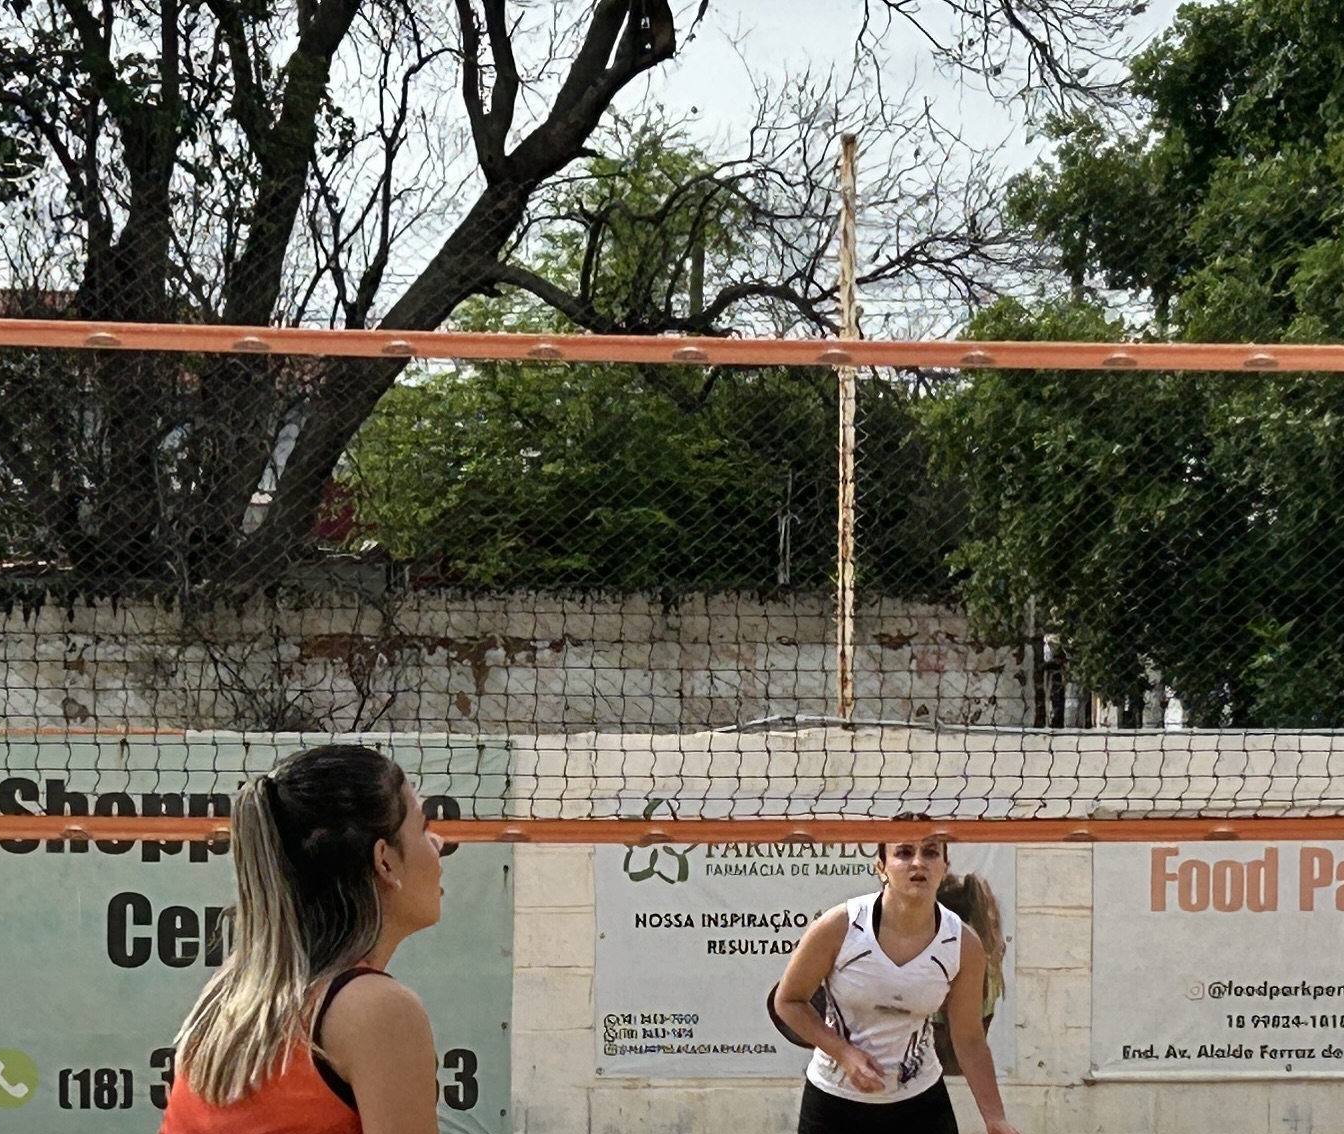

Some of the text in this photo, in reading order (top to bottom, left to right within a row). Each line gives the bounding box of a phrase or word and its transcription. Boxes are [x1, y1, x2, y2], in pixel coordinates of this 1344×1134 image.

[791, 863, 809, 876] DE
[815, 863, 877, 876] MANIPU
[1151, 847, 1279, 912] Food
[635, 910, 808, 933] NOSSA INSPIRAÇÃO
[1226, 1014, 1245, 1029] 18
[1122, 1045, 1159, 1059] End.
[1164, 1045, 1191, 1059] Av.
[1259, 1045, 1316, 1059] Ferraz
[1321, 1044, 1343, 1059] de
[58, 1067, 134, 1110] (18)
